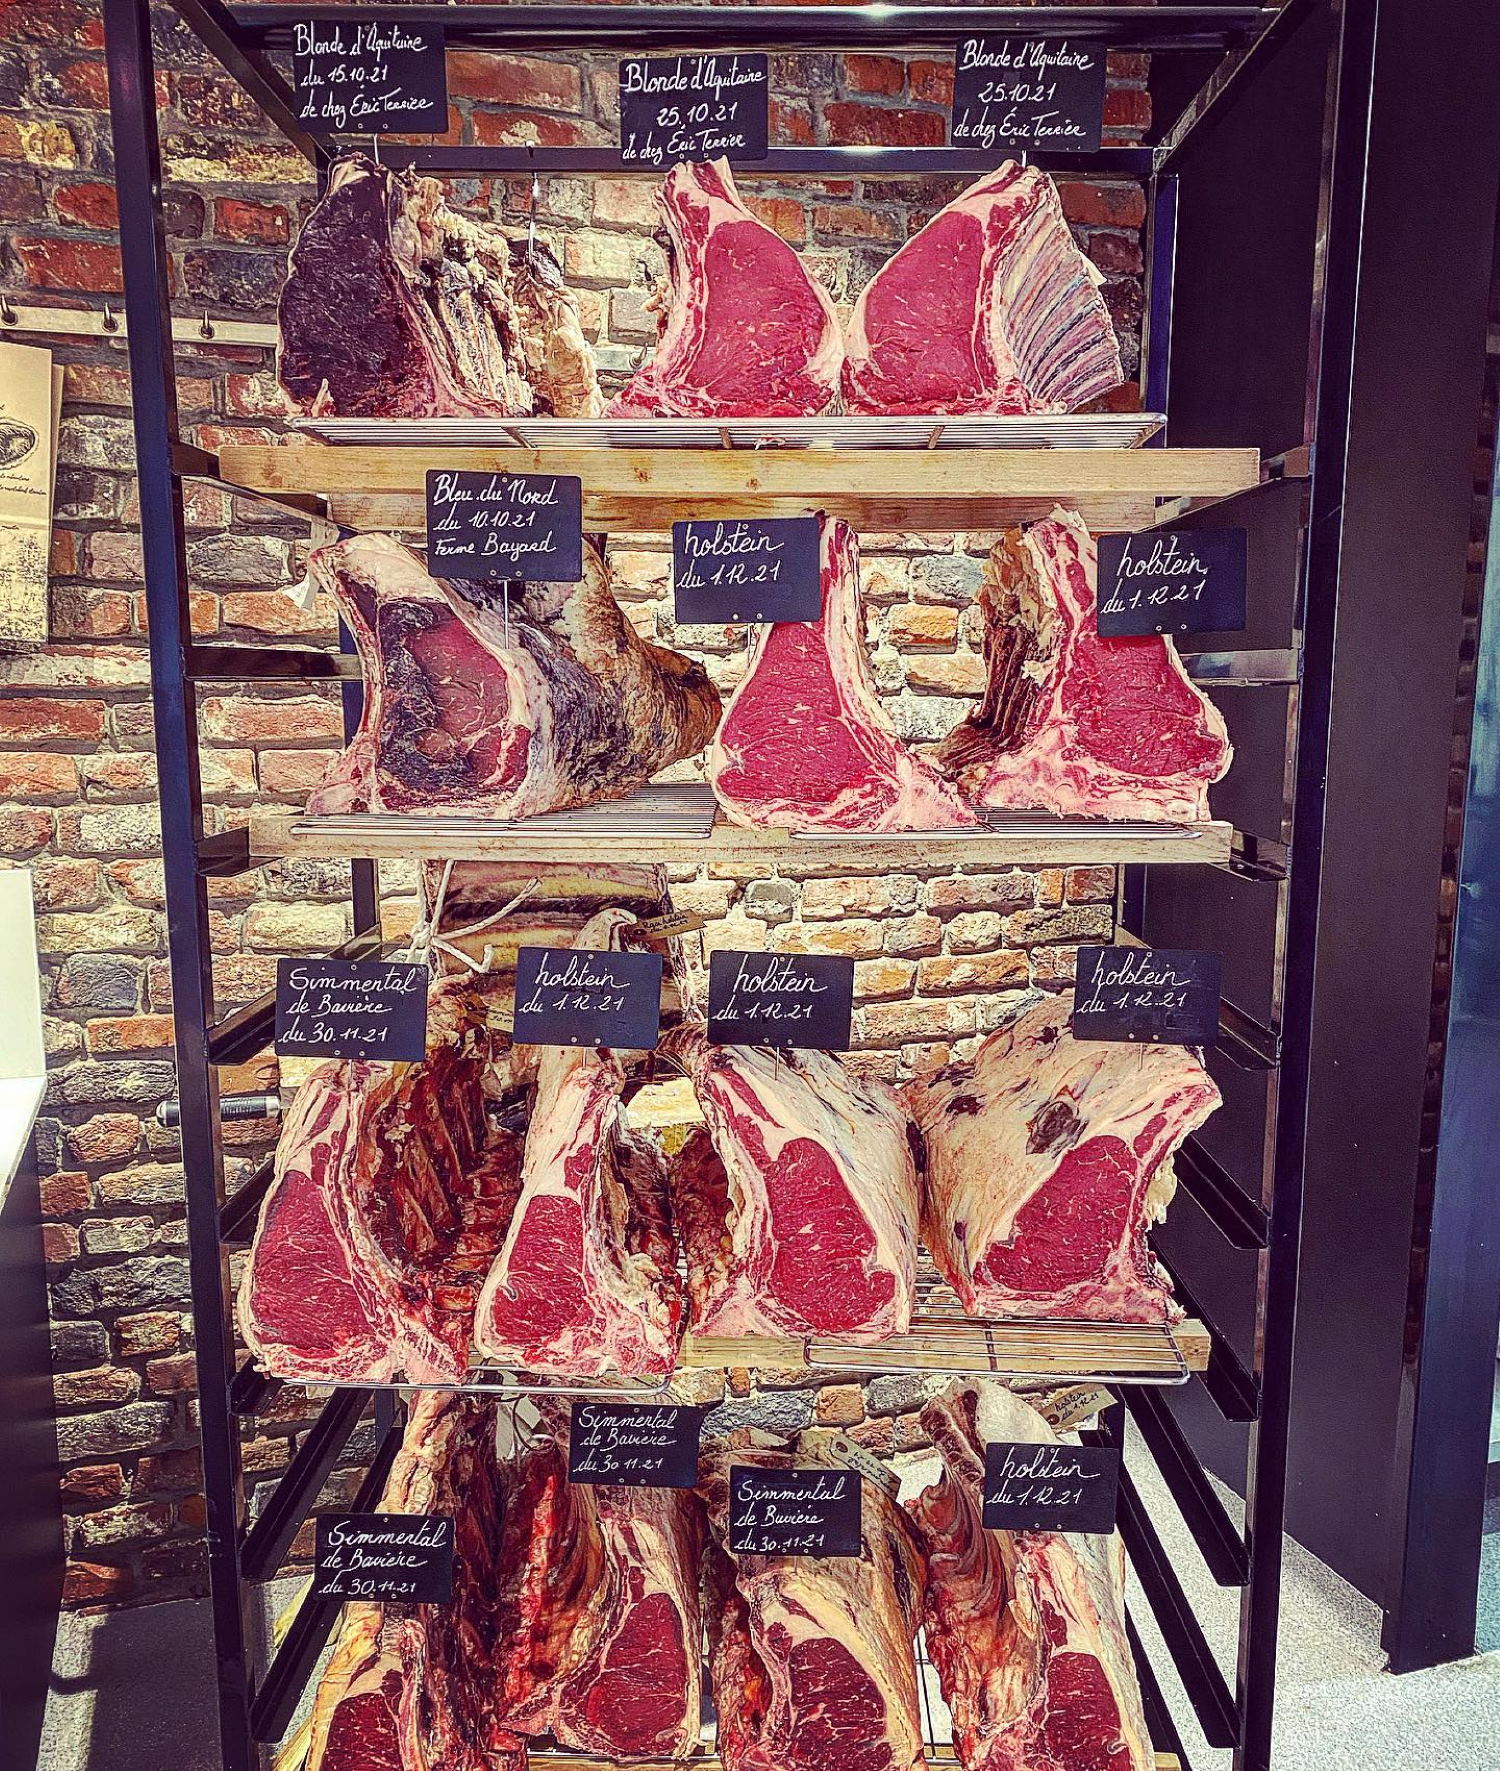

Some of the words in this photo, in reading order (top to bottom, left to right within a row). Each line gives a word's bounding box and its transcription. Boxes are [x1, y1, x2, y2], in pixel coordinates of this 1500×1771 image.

[293, 20, 347, 56] Blonde
[349, 21, 428, 62] d'Aquitaine
[300, 58, 325, 87] du
[327, 64, 388, 83] 15.10.21
[959, 39, 1011, 71] Blonde
[1012, 40, 1095, 81] d'Aquitaine
[624, 56, 688, 93] Blonde
[690, 54, 767, 102] d'Aquitaine
[977, 81, 1057, 103] 25.10.21
[300, 88, 318, 119] de
[321, 90, 347, 129] chez
[656, 101, 738, 127] 25.10.21
[953, 108, 970, 137] de
[971, 105, 996, 149] chez
[622, 132, 637, 160] de
[640, 131, 664, 166] chez
[433, 472, 473, 506] Bleu
[507, 479, 559, 505] Nord
[432, 501, 461, 531] du
[468, 510, 536, 528] 10.10.21
[434, 537, 475, 556] Ferme
[481, 530, 557, 561] Bayard
[684, 521, 785, 557] holstein
[675, 559, 706, 589] du
[1100, 577, 1126, 614] du
[288, 965, 417, 993] Simmental
[534, 952, 631, 989] holstein
[732, 953, 829, 993] holstein
[1090, 950, 1192, 986] holstein
[285, 989, 310, 1014] de
[518, 987, 544, 1013] du
[711, 994, 740, 1020] du
[1075, 985, 1107, 1014] du
[277, 1015, 306, 1043] du
[308, 1022, 388, 1043] 30.11.21
[579, 1405, 678, 1429] Simmental
[579, 1426, 602, 1446] de
[572, 1447, 598, 1472] du
[999, 1445, 1101, 1479] holstein
[737, 1475, 847, 1501] Simmental
[985, 1478, 1015, 1504] du
[733, 1501, 758, 1527] de
[328, 1519, 447, 1547] Simmental
[733, 1528, 757, 1550] du
[320, 1545, 343, 1568] de
[318, 1571, 344, 1594] du
